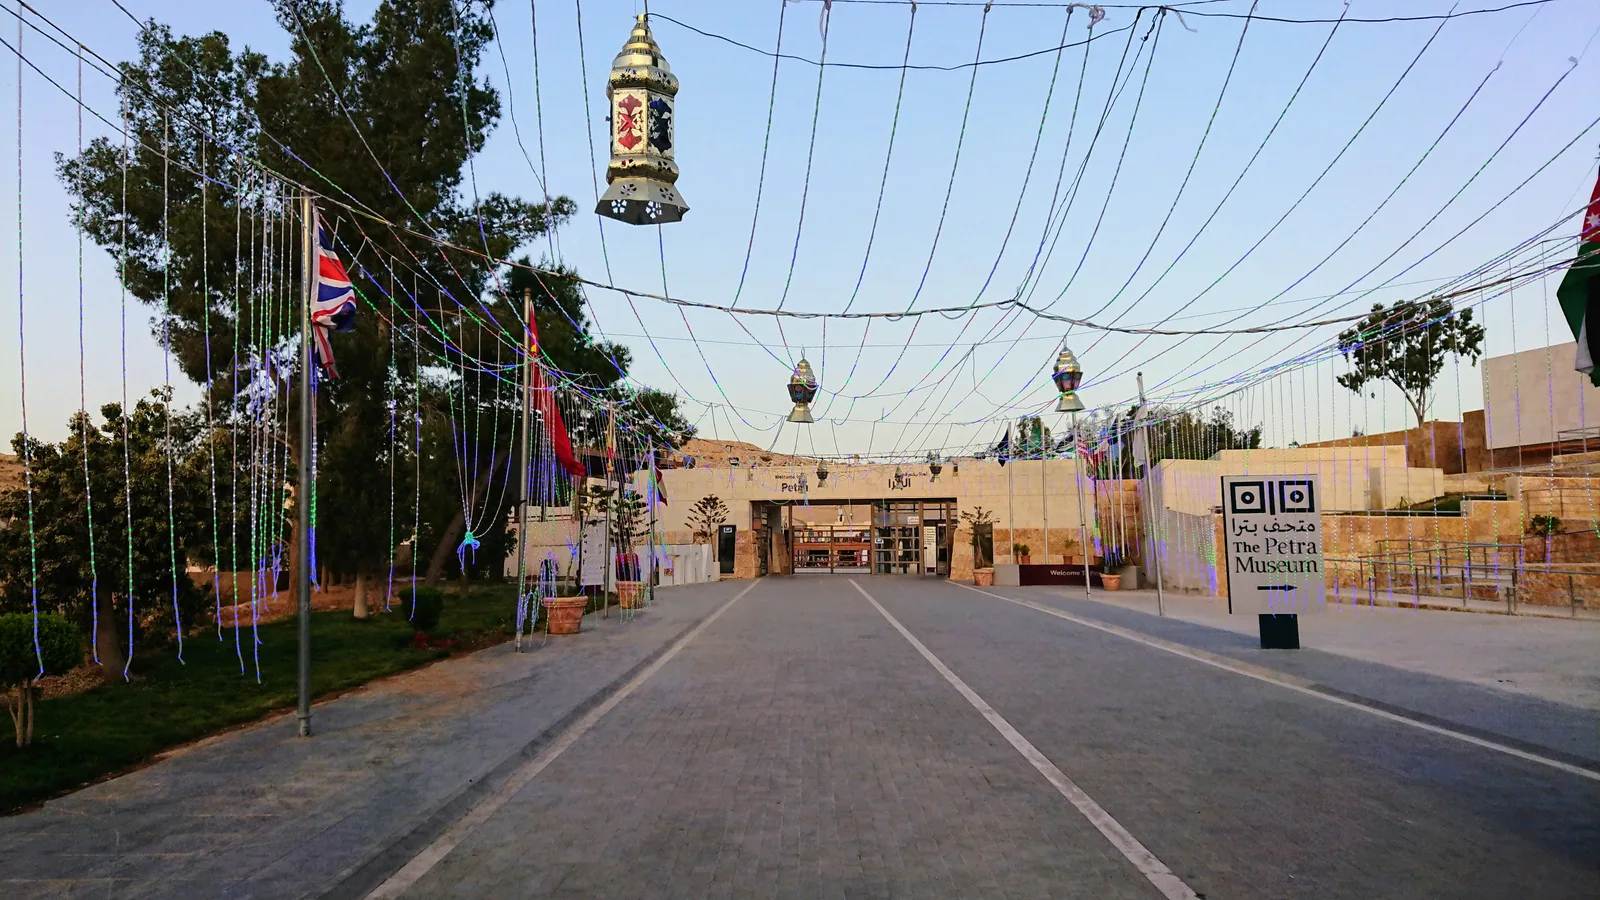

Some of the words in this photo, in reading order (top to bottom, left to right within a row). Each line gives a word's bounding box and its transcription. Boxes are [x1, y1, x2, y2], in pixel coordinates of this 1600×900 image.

[1231, 517, 1258, 537] بترا
[1263, 517, 1316, 533] متحف
[1232, 541, 1261, 554] The
[1264, 537, 1318, 555] Petra
[1235, 556, 1319, 574] Museum
